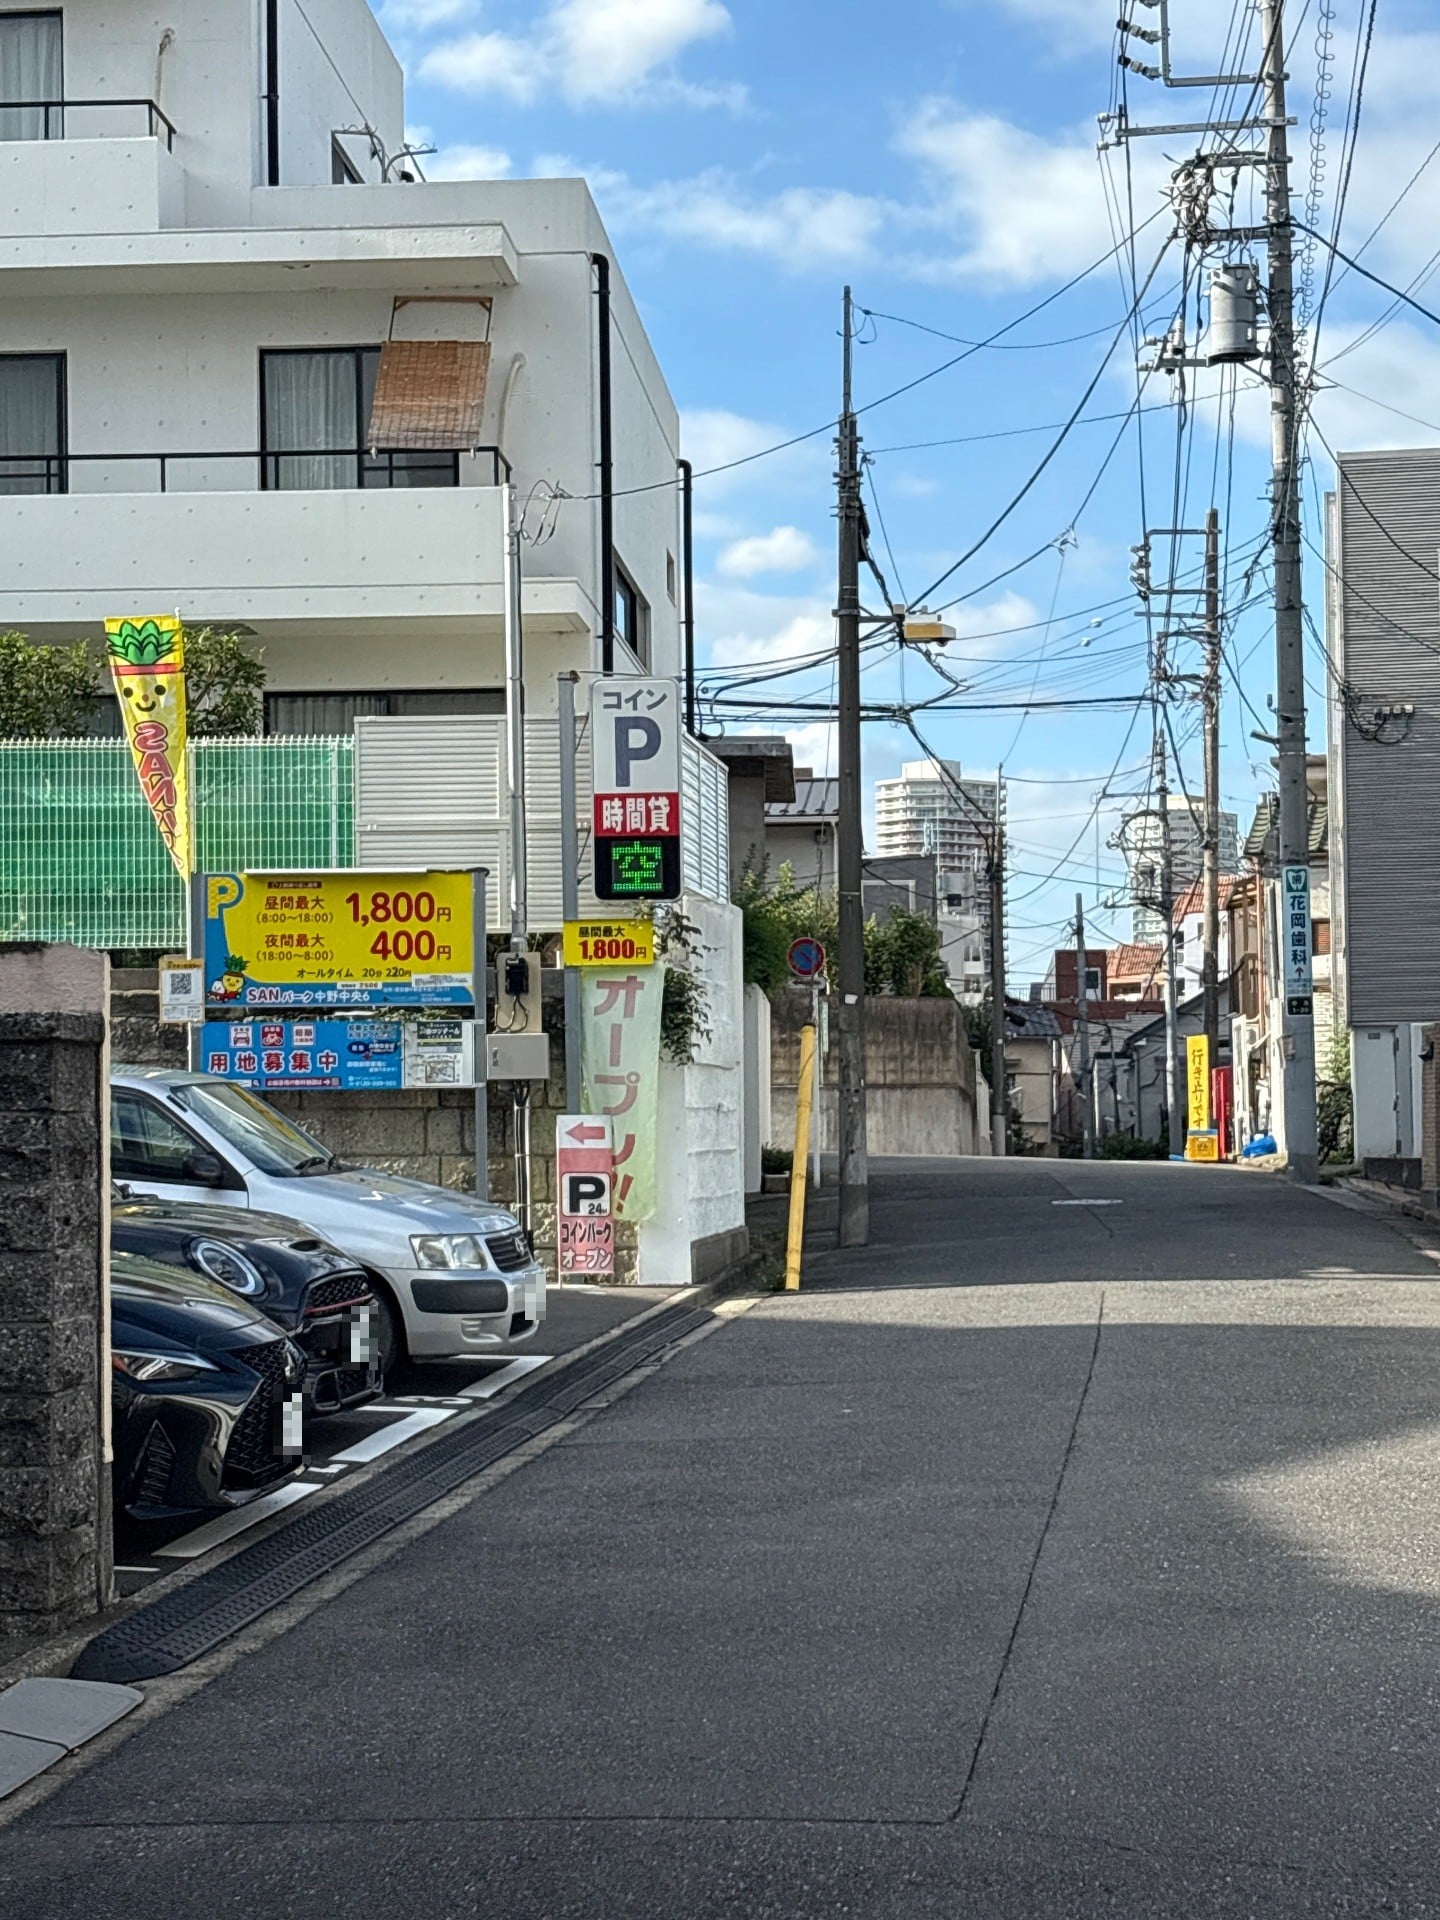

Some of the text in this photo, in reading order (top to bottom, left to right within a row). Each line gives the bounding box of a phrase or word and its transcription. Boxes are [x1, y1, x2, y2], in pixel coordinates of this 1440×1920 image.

[603, 689, 668, 711] コイン
[615, 716, 661, 787] P
[602, 796, 670, 832] 時間貸
[612, 840, 663, 892] 空
[207, 876, 240, 919] P
[265, 891, 452, 927] 昼間最大 1,800円
[265, 930, 452, 961] 夜間最大 400円
[579, 926, 625, 938] 昼間最大
[1290, 895, 1307, 966] 花岡歯科
[578, 939, 647, 961] 1,800円
[297, 968, 354, 978] オールタイム
[362, 968, 382, 978] 20分
[209, 1050, 338, 1074] 用地募集中
[569, 1176, 606, 1214] P
[561, 1221, 612, 1244] コインパーク
[562, 1248, 613, 1269] オープン
